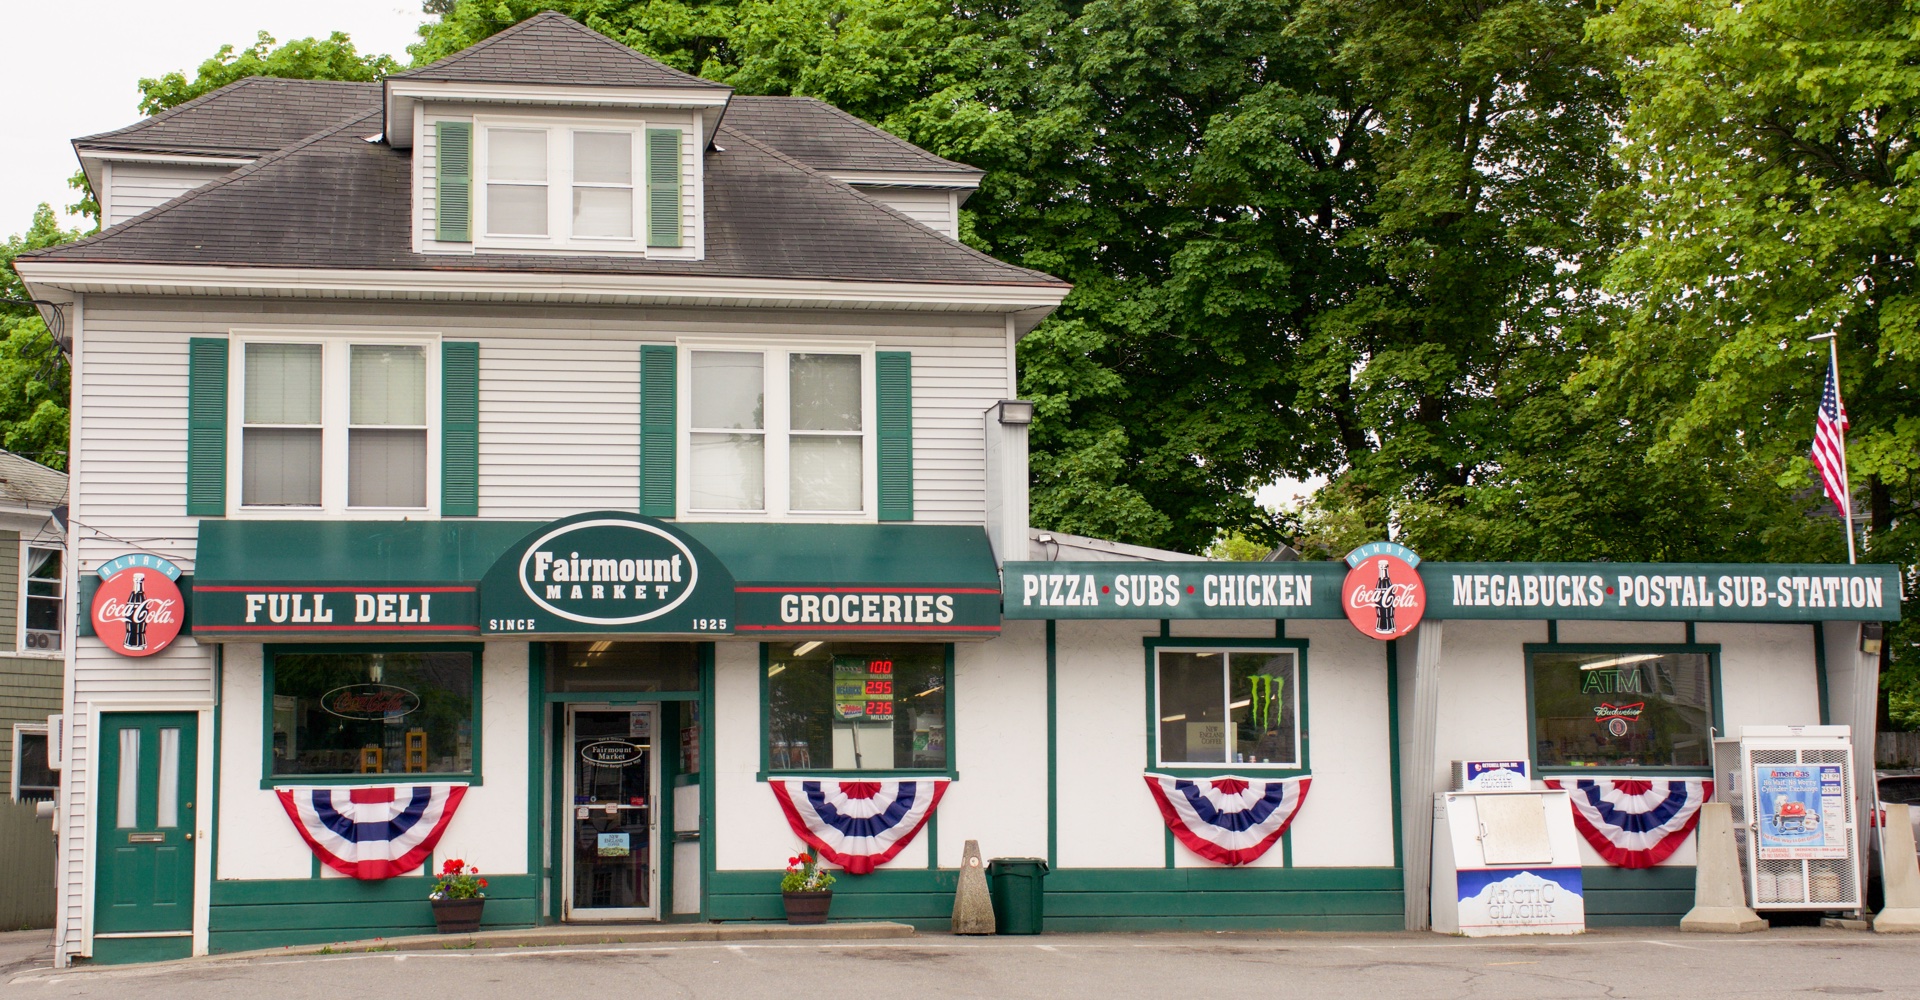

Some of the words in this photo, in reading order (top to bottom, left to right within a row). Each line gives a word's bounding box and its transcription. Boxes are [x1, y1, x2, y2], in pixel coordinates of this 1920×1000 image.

[1350, 543, 1415, 563] ALWAYS
[102, 555, 175, 576] ALWAYS
[534, 551, 682, 583] Fairmount
[546, 584, 669, 600] MARKET
[1022, 574, 1099, 606] PIZZA
[1114, 574, 1180, 607] SUBS
[1203, 574, 1312, 607] CHICKEN
[1350, 583, 1418, 609] Coca-Cola
[1452, 574, 1604, 607] MEGABUCKS
[1618, 575, 1714, 607] POSTAL
[1718, 575, 1883, 608] SUB-STATION
[98, 597, 175, 624] Coca-Cola
[245, 594, 333, 623] FULL
[354, 594, 431, 623] DELI
[780, 594, 954, 623] GROCERIES
[489, 618, 536, 631] SINCE
[692, 618, 727, 630] 1925
[869, 660, 893, 674] 100
[1582, 669, 1642, 694] ATM
[865, 701, 892, 715] 235
[1593, 706, 1643, 717] Budweiser
[1770, 770, 1810, 778] AmeriGas
[1487, 884, 1555, 905] ARCTIC
[1488, 904, 1556, 919] GLACIER
